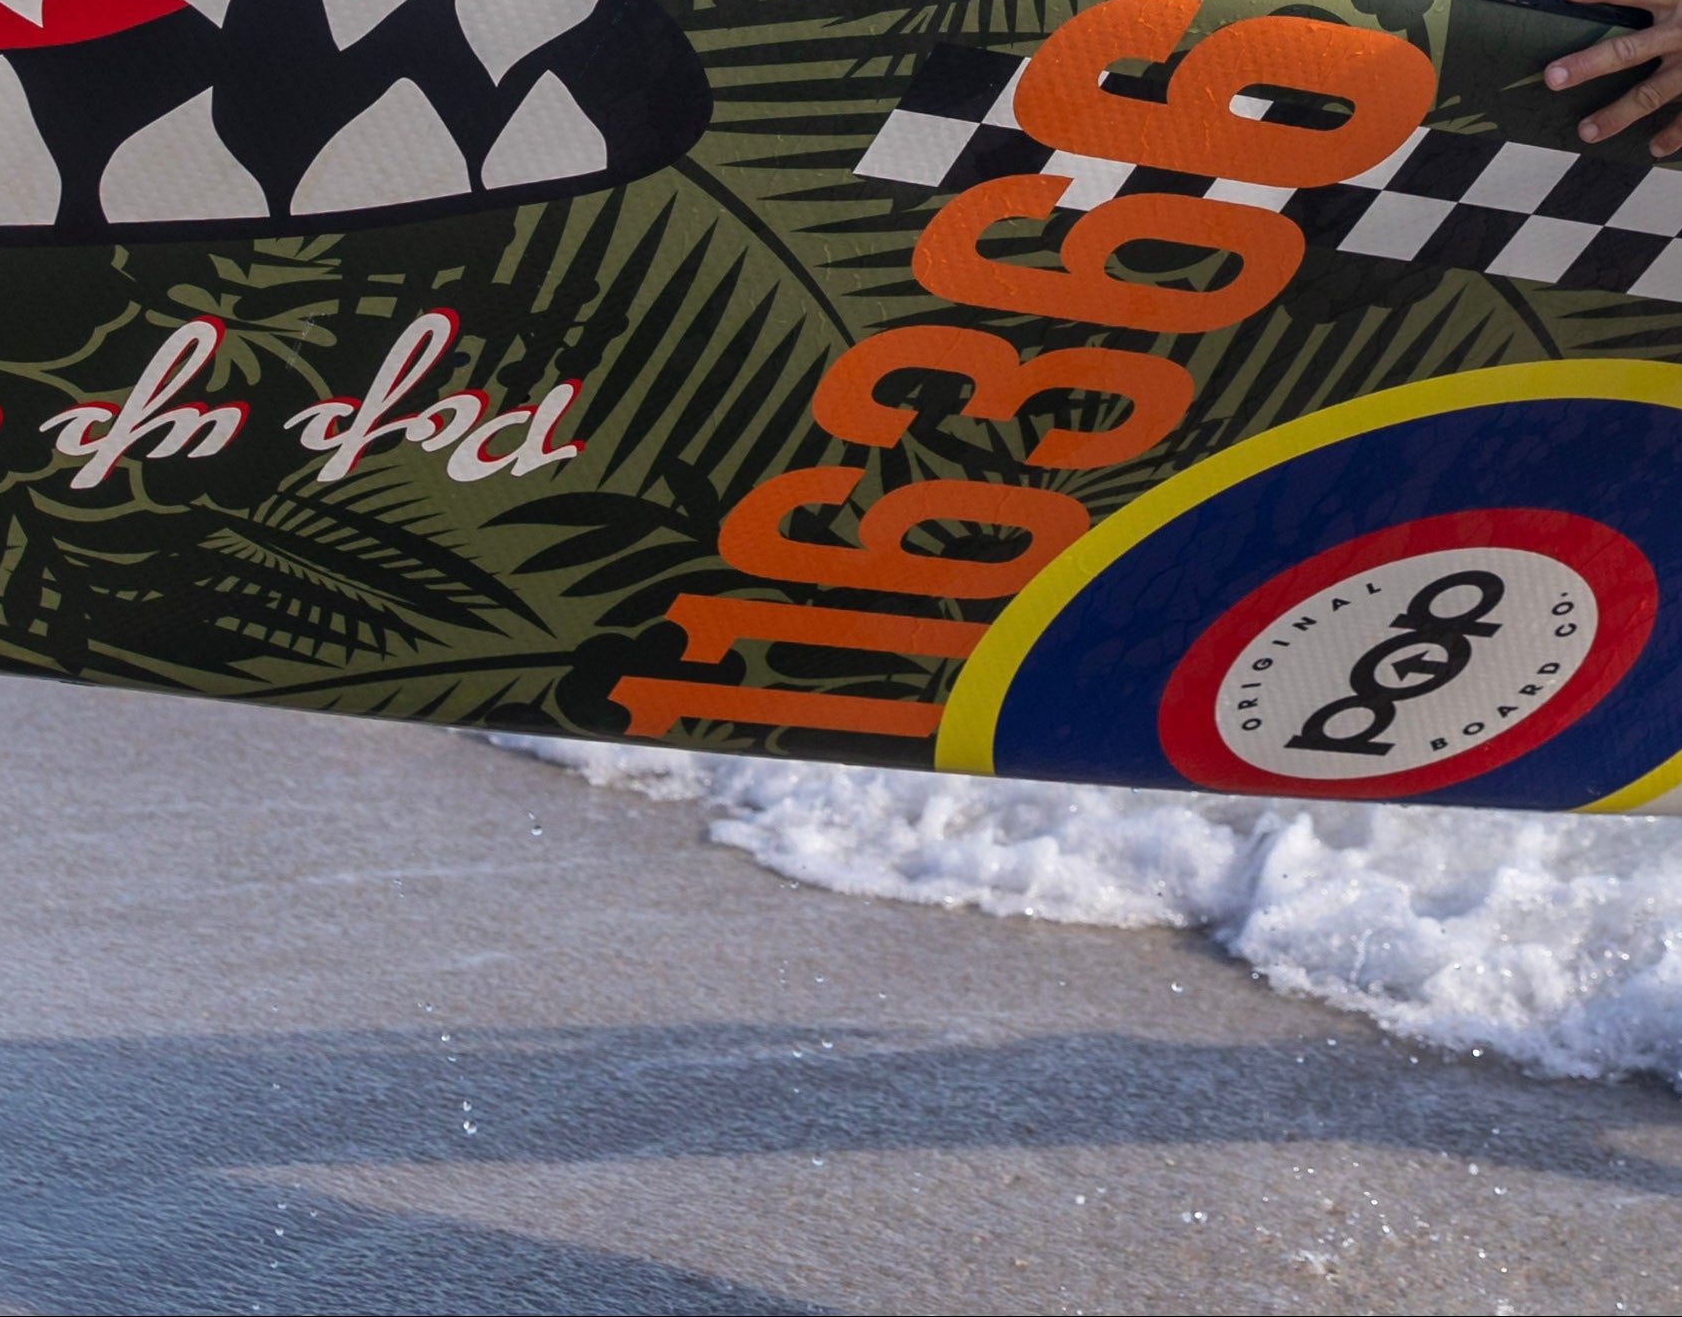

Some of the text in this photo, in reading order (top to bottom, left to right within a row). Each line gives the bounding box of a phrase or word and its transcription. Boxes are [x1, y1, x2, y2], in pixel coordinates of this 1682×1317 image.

[38, 316, 250, 490] up
[282, 308, 586, 484] Pop
[1236, 582, 1382, 732] ORIGINAL
[1283, 569, 1506, 757] pop
[1429, 661, 1561, 752] BOARD
